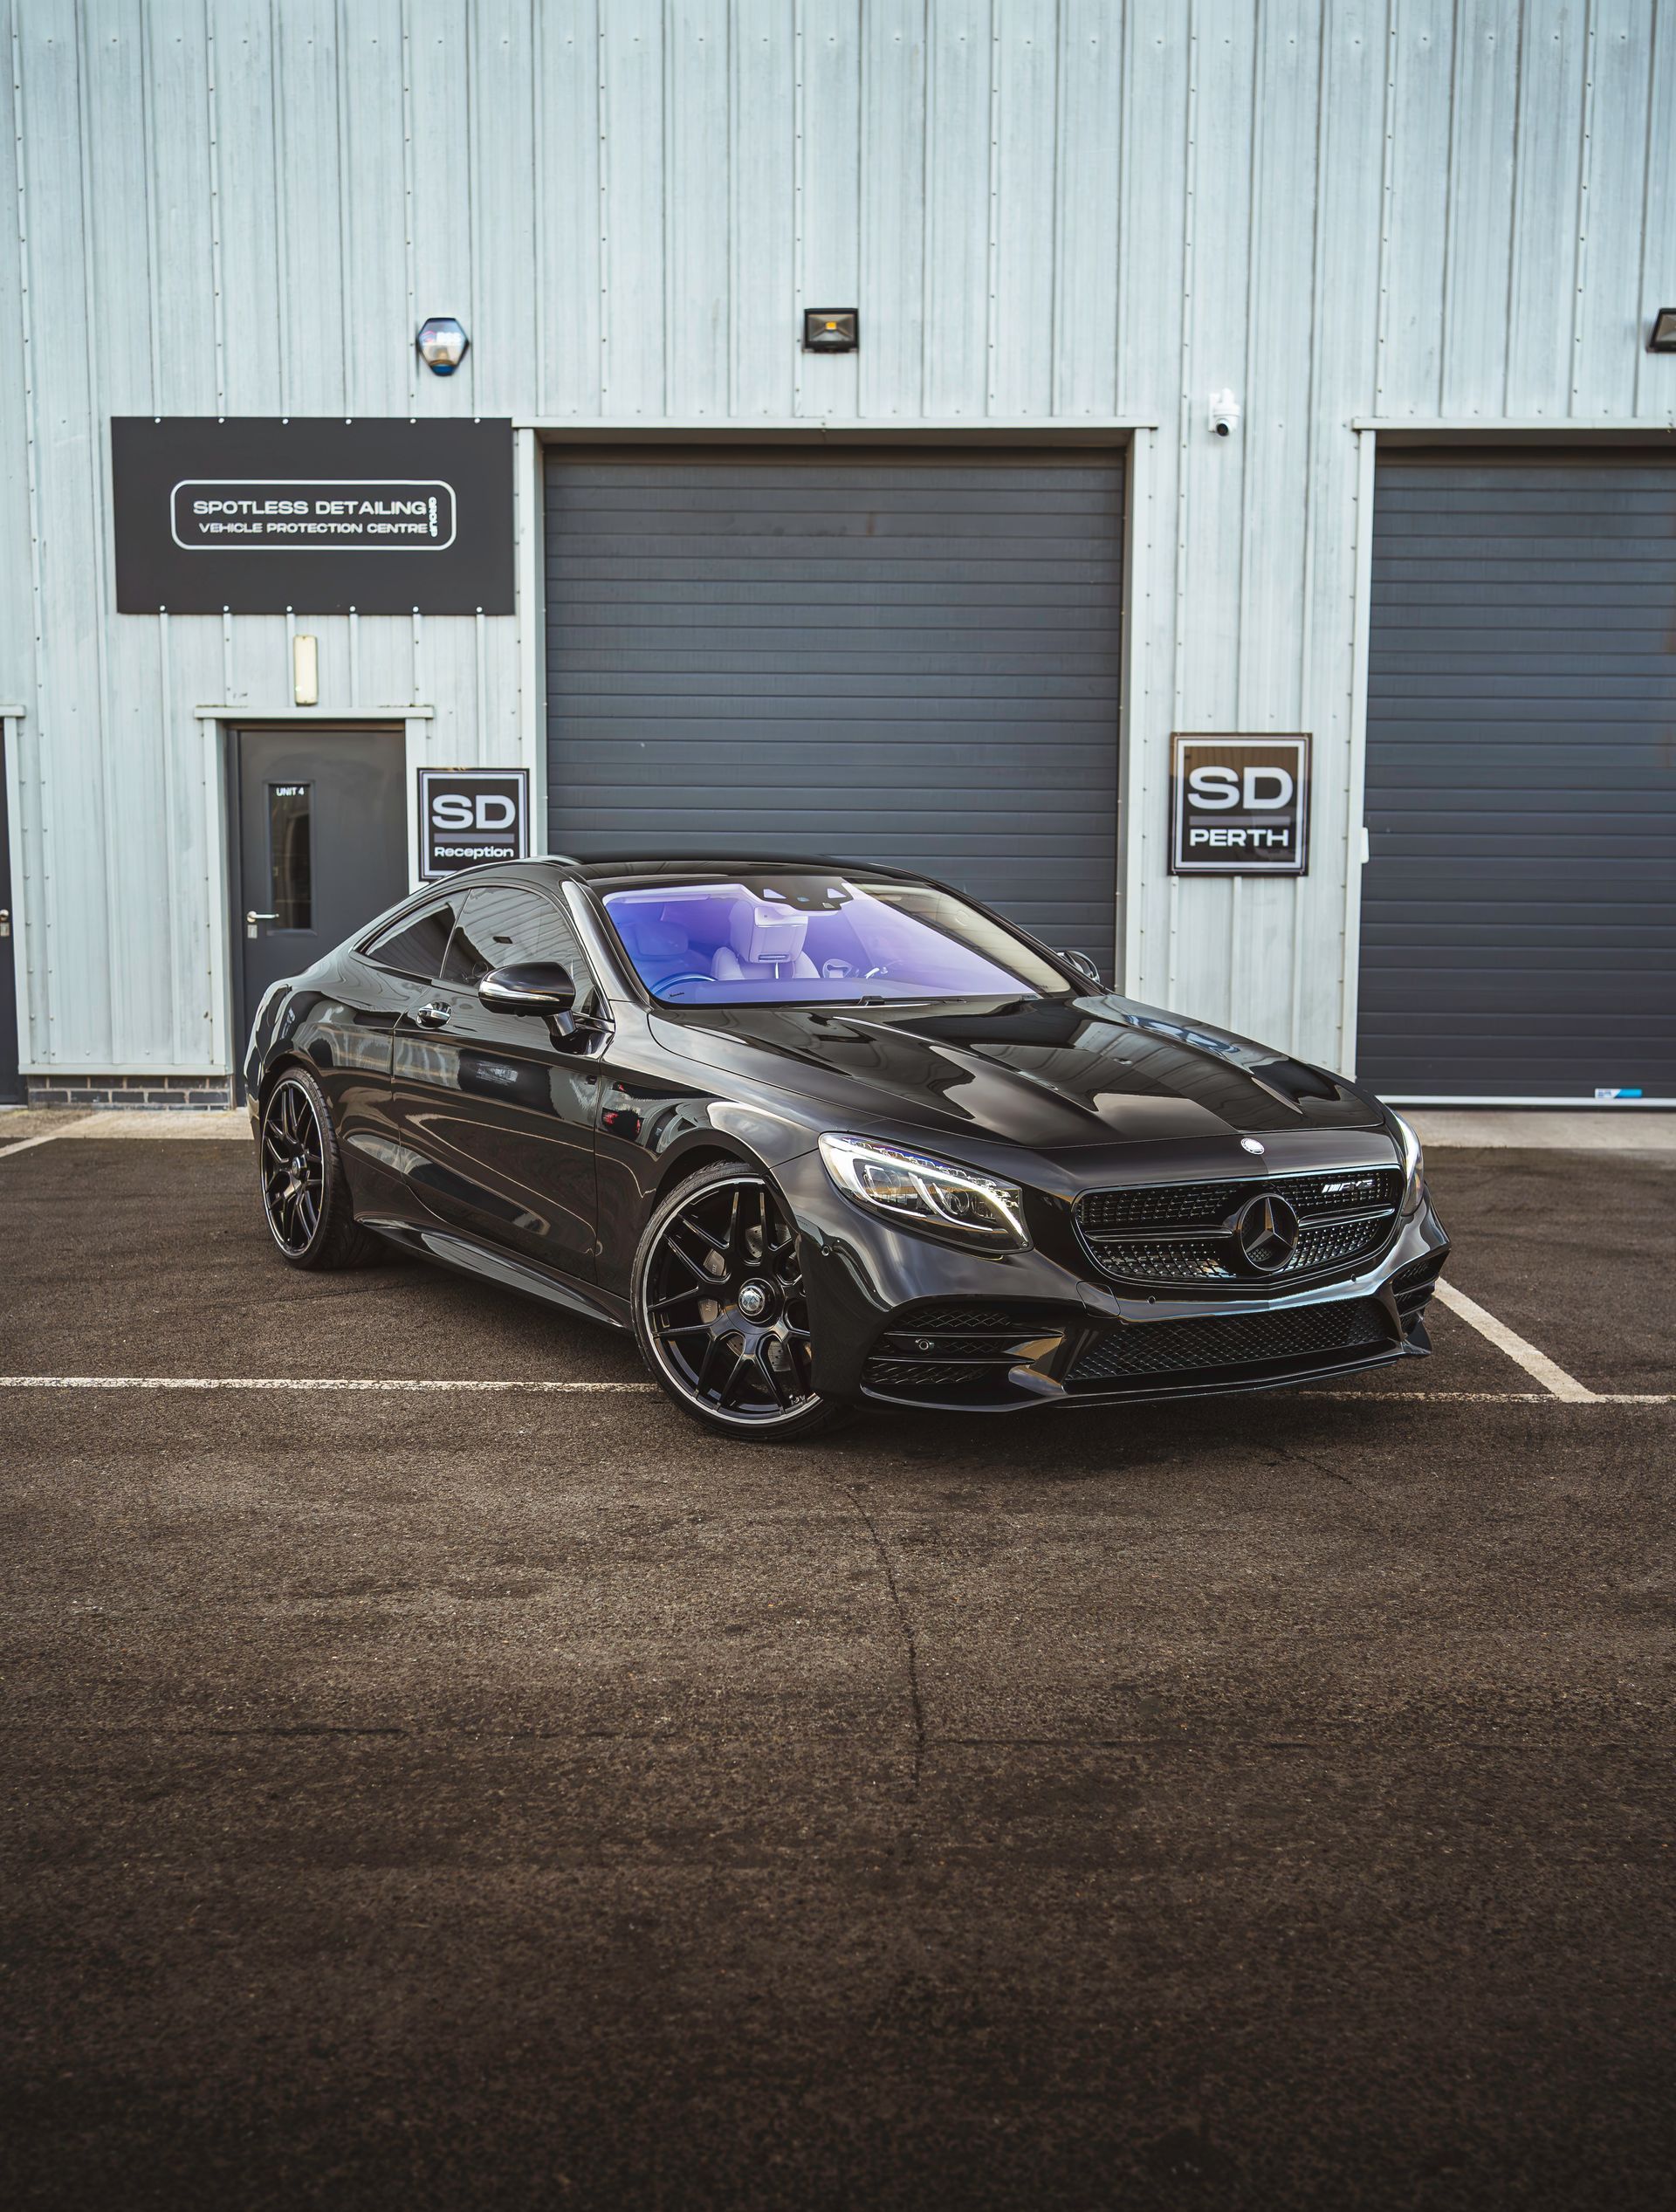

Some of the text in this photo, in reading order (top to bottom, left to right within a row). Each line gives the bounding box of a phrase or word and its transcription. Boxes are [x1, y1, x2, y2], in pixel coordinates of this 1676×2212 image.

[193, 500, 427, 515] SPOTLESS DETAILING
[429, 496, 438, 538] GROUP
[198, 522, 428, 534] VEHICLE PROTECTION CENTRE
[276, 787, 305, 796] UNIT 4
[1187, 766, 1293, 810] SD
[431, 793, 516, 829] SD
[1190, 828, 1289, 847] PERTH
[434, 845, 515, 860] Reception
